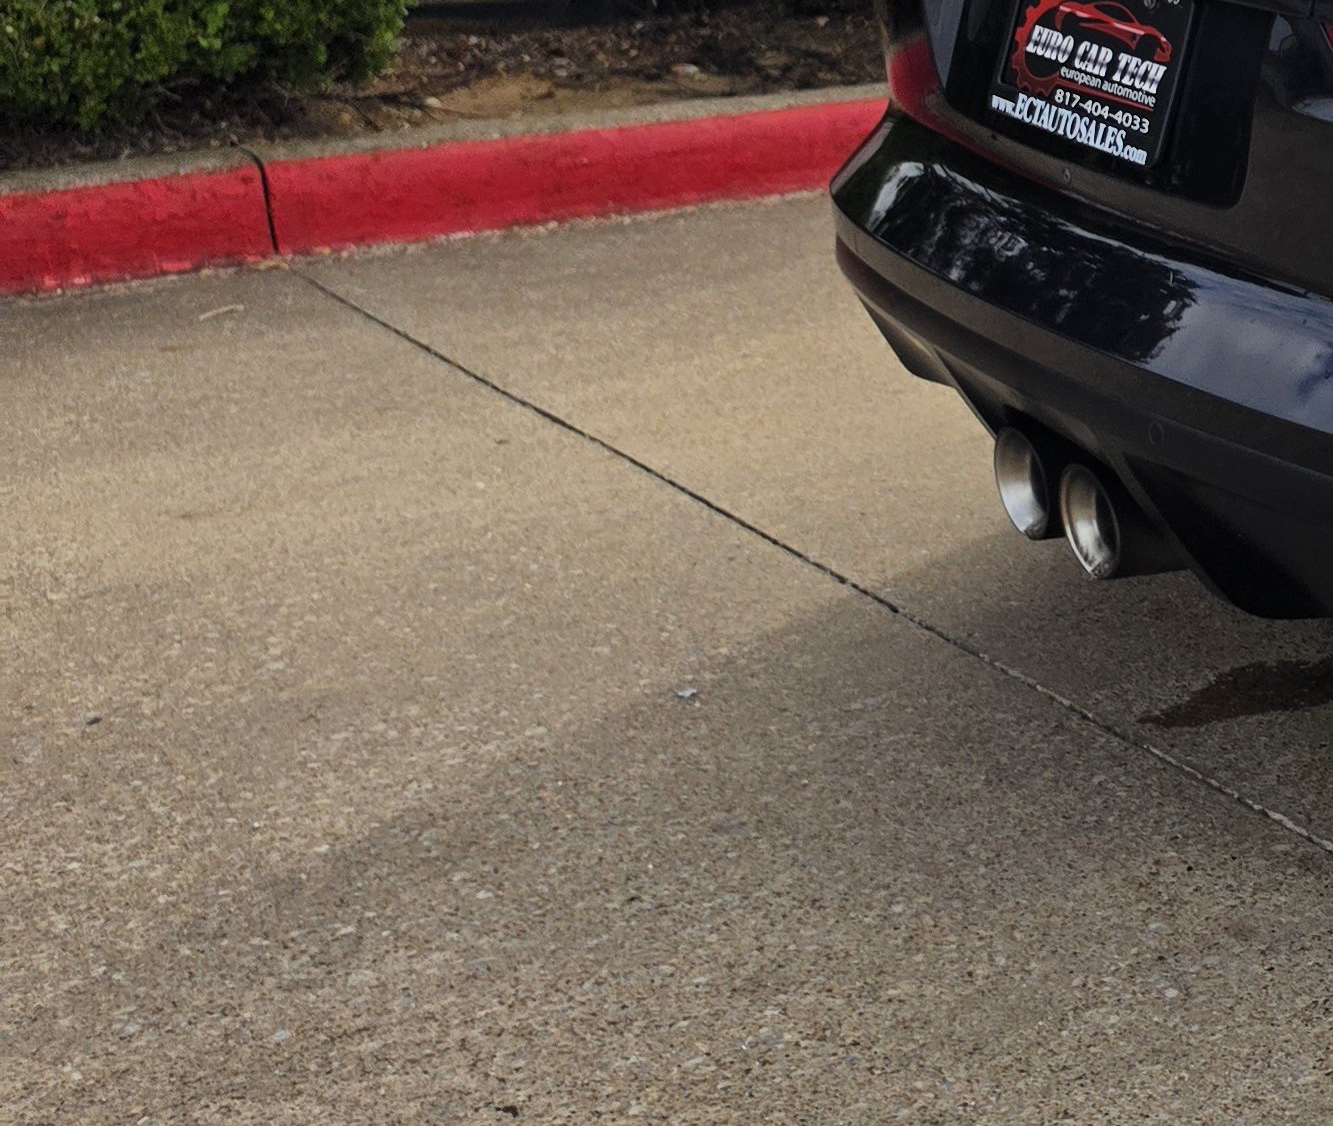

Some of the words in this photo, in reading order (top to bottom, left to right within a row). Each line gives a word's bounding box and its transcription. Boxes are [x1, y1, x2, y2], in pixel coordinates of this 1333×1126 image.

[1026, 25, 1074, 63] EURO
[1075, 40, 1113, 75] CAR
[1111, 52, 1168, 94] TECH
[1060, 66, 1101, 89] european
[1102, 79, 1156, 108] automotive
[991, 93, 1148, 165] www.ECTAUTOSALES.com
[1054, 88, 1150, 134] 817-404-4033
